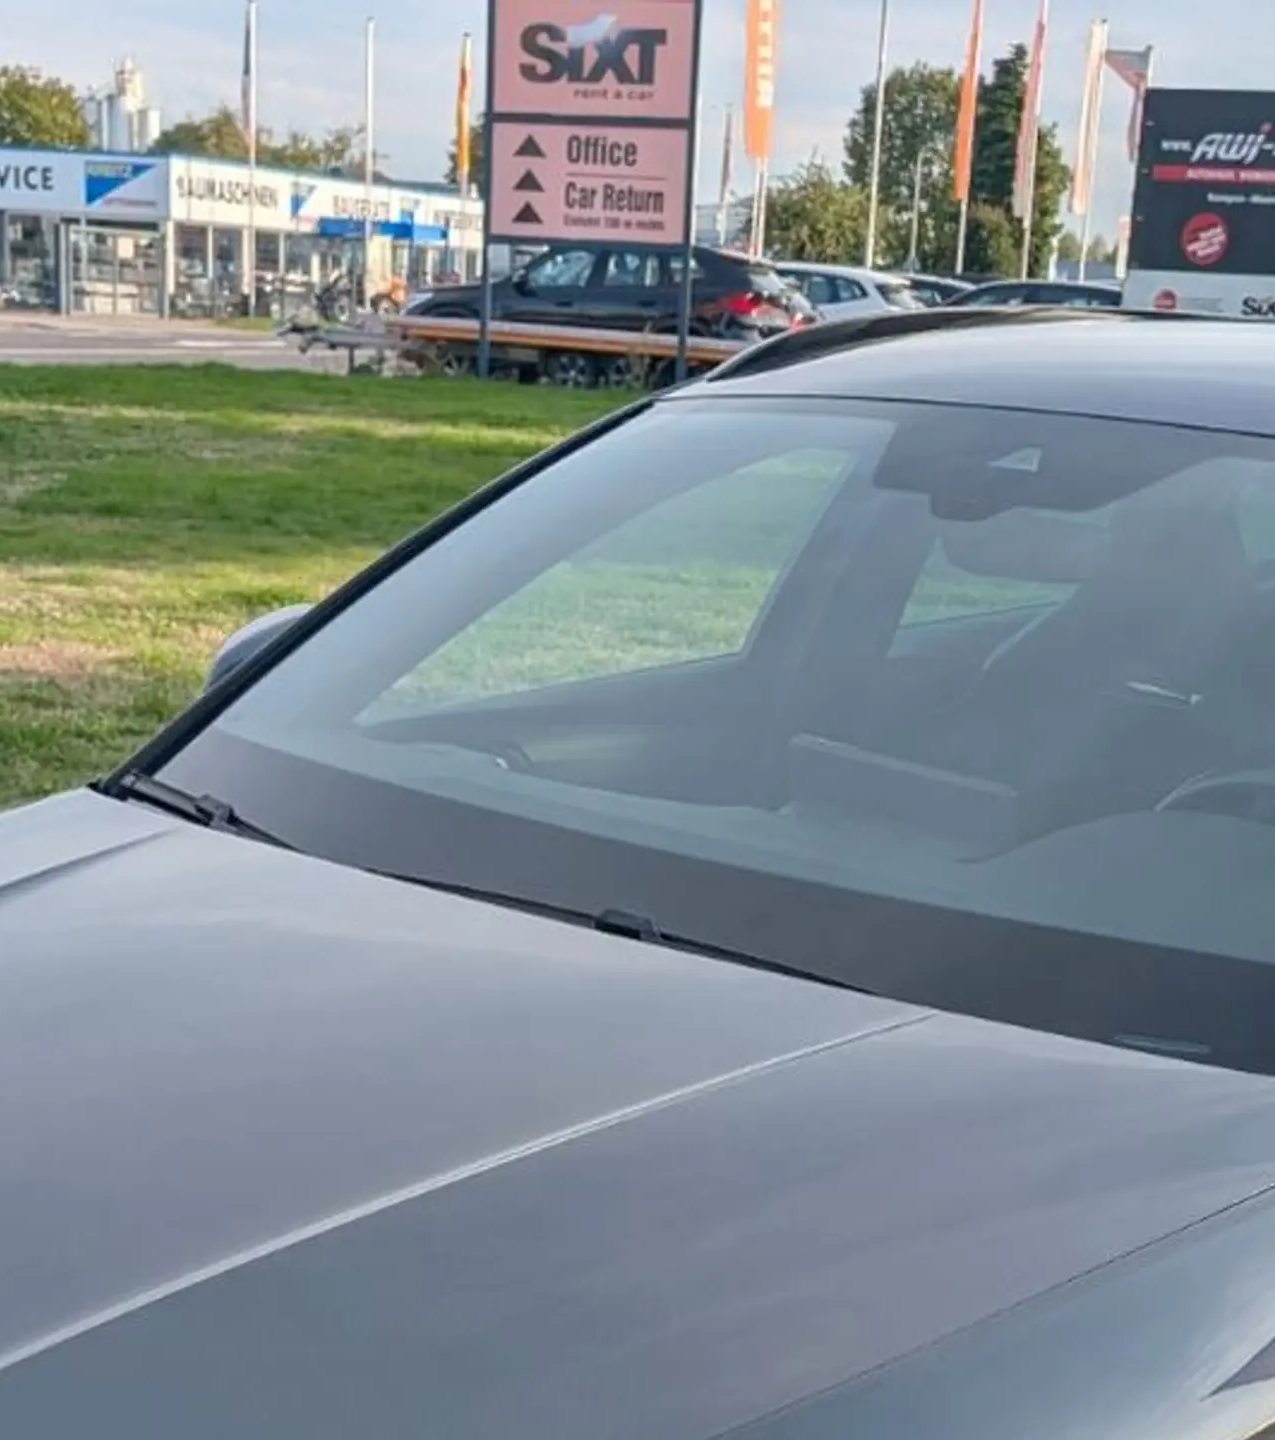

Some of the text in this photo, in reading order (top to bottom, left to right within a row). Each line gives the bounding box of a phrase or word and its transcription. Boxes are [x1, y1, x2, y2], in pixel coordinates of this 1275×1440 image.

[567, 134, 638, 167] Office
[176, 176, 278, 210] BAUMASCHNEN
[564, 181, 664, 214] Car Return
